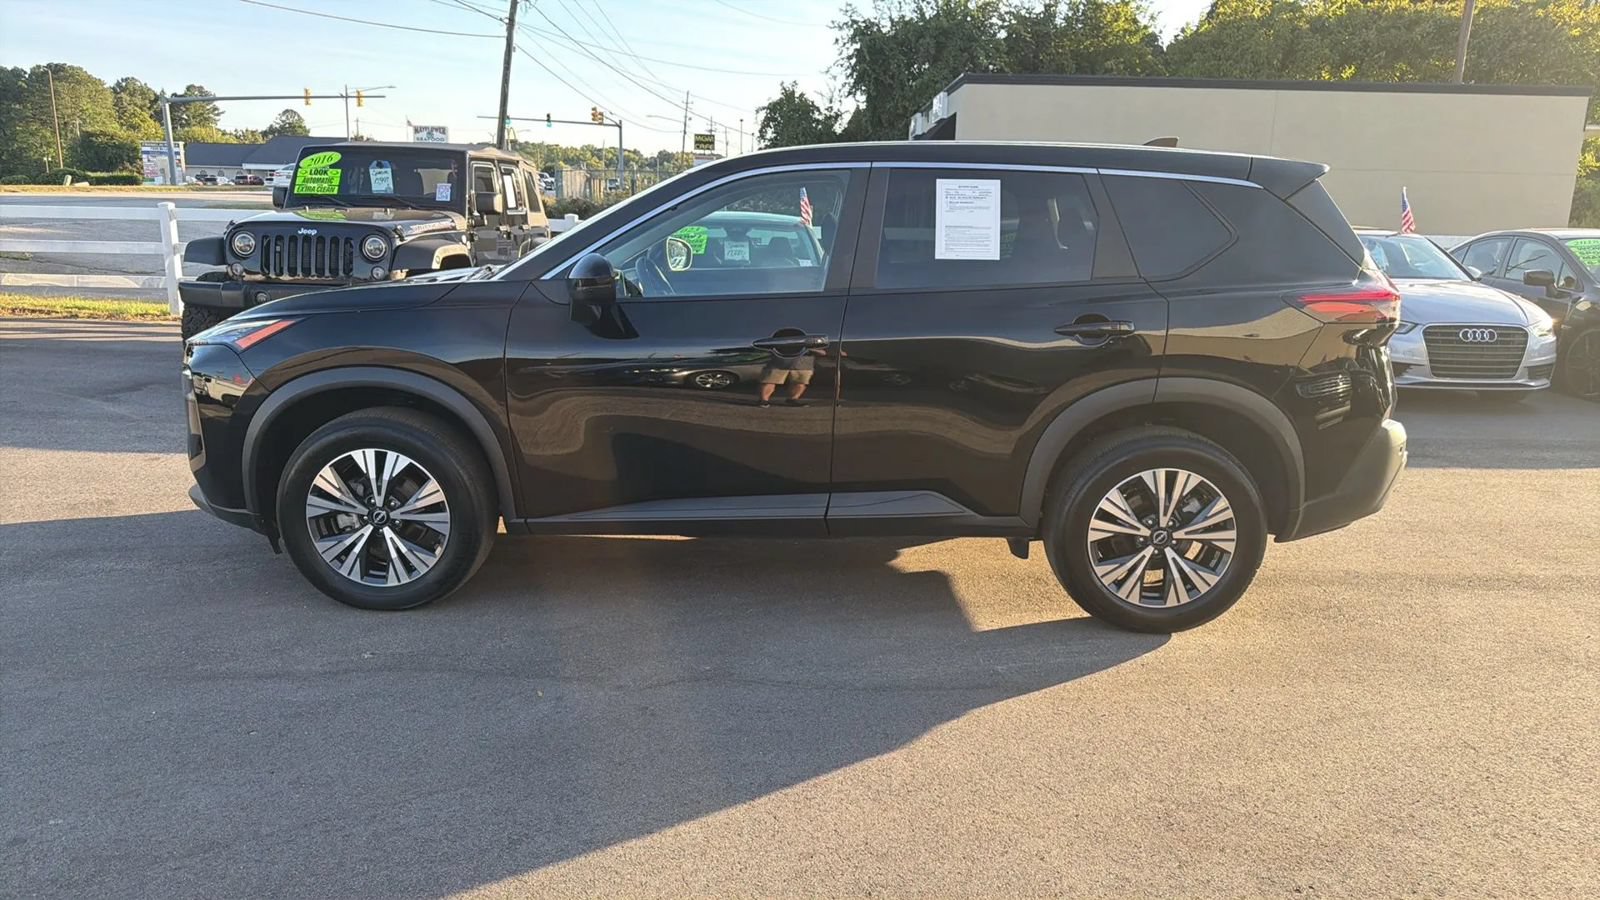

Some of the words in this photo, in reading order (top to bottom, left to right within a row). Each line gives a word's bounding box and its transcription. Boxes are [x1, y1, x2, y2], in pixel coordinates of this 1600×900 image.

[307, 154, 334, 167] 2016
[309, 168, 329, 176] LOOK
[298, 227, 317, 235] Jeep
